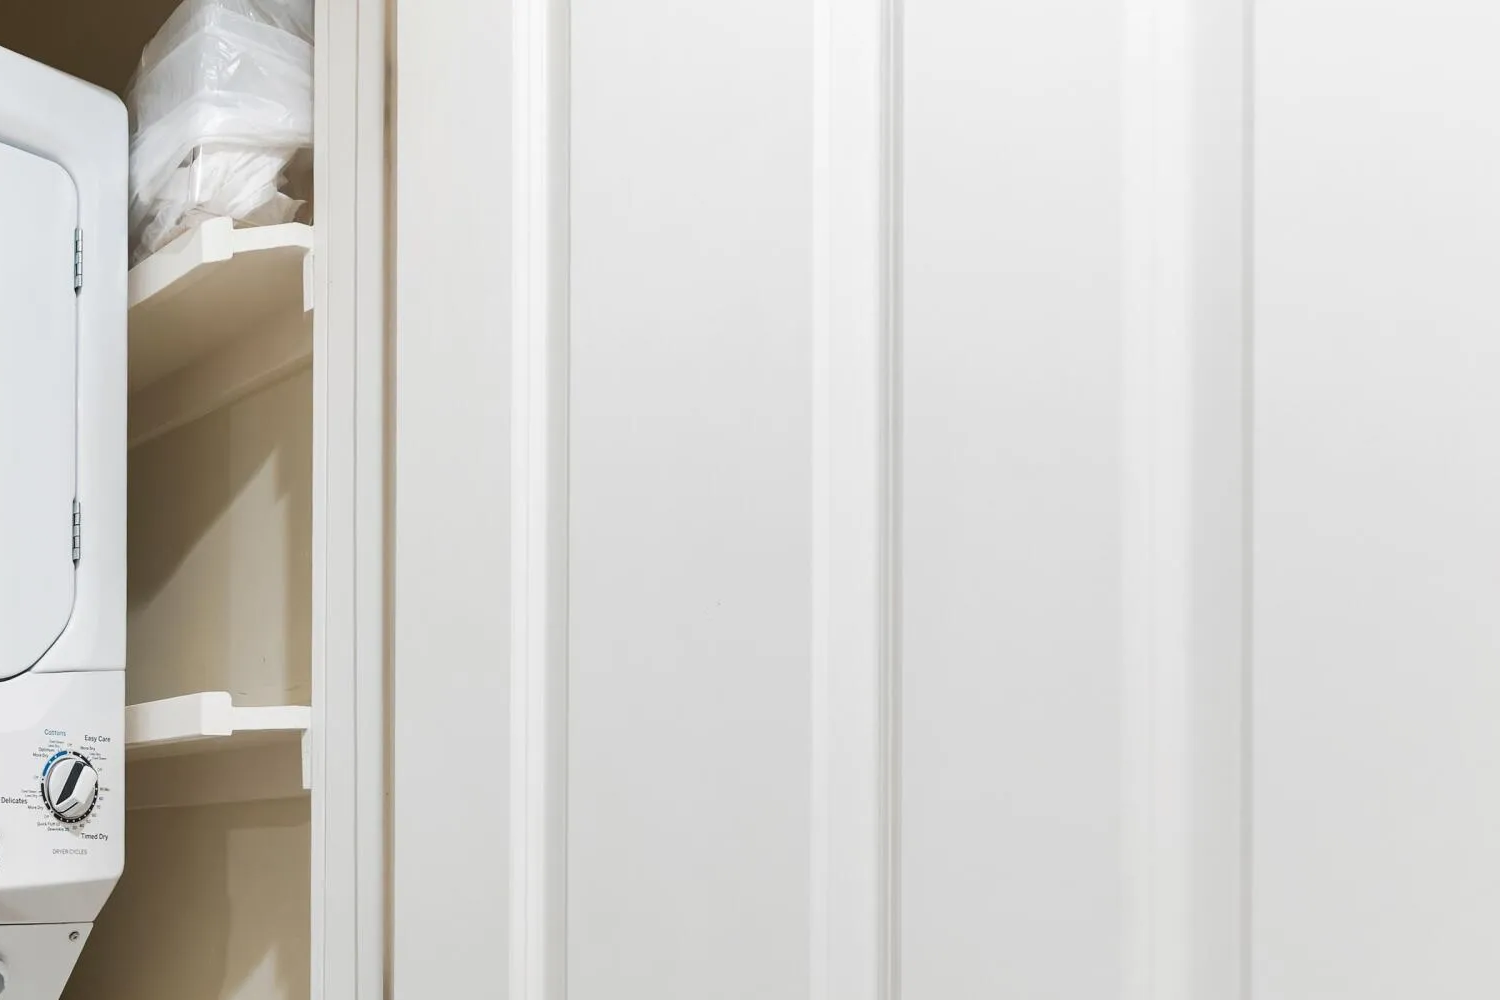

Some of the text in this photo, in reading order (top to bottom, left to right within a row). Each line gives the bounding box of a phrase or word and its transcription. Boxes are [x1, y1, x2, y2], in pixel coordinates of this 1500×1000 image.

[84, 735, 98, 743] Easy
[0, 796, 28, 804] Delicates
[81, 832, 98, 840] Timed
